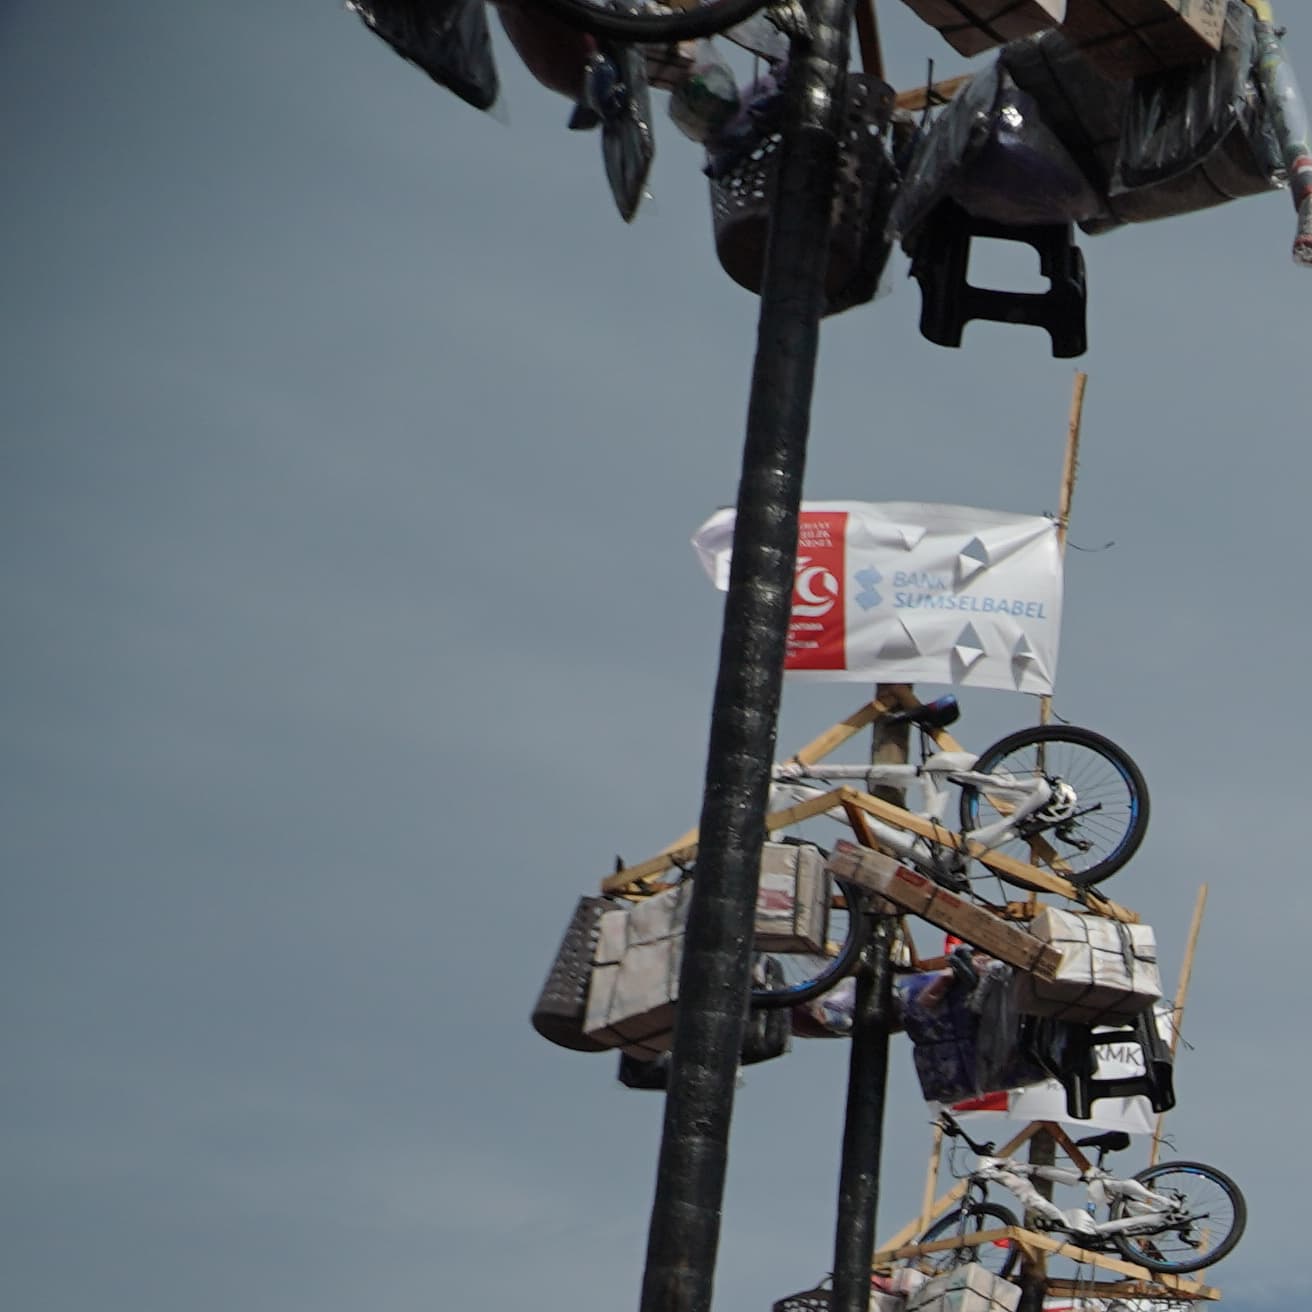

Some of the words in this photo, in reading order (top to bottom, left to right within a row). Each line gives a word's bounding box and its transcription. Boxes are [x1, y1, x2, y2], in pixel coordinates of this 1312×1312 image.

[792, 555, 839, 618] 9
[893, 569, 949, 591] BANK
[892, 591, 1047, 620] SUMSELBABEL
